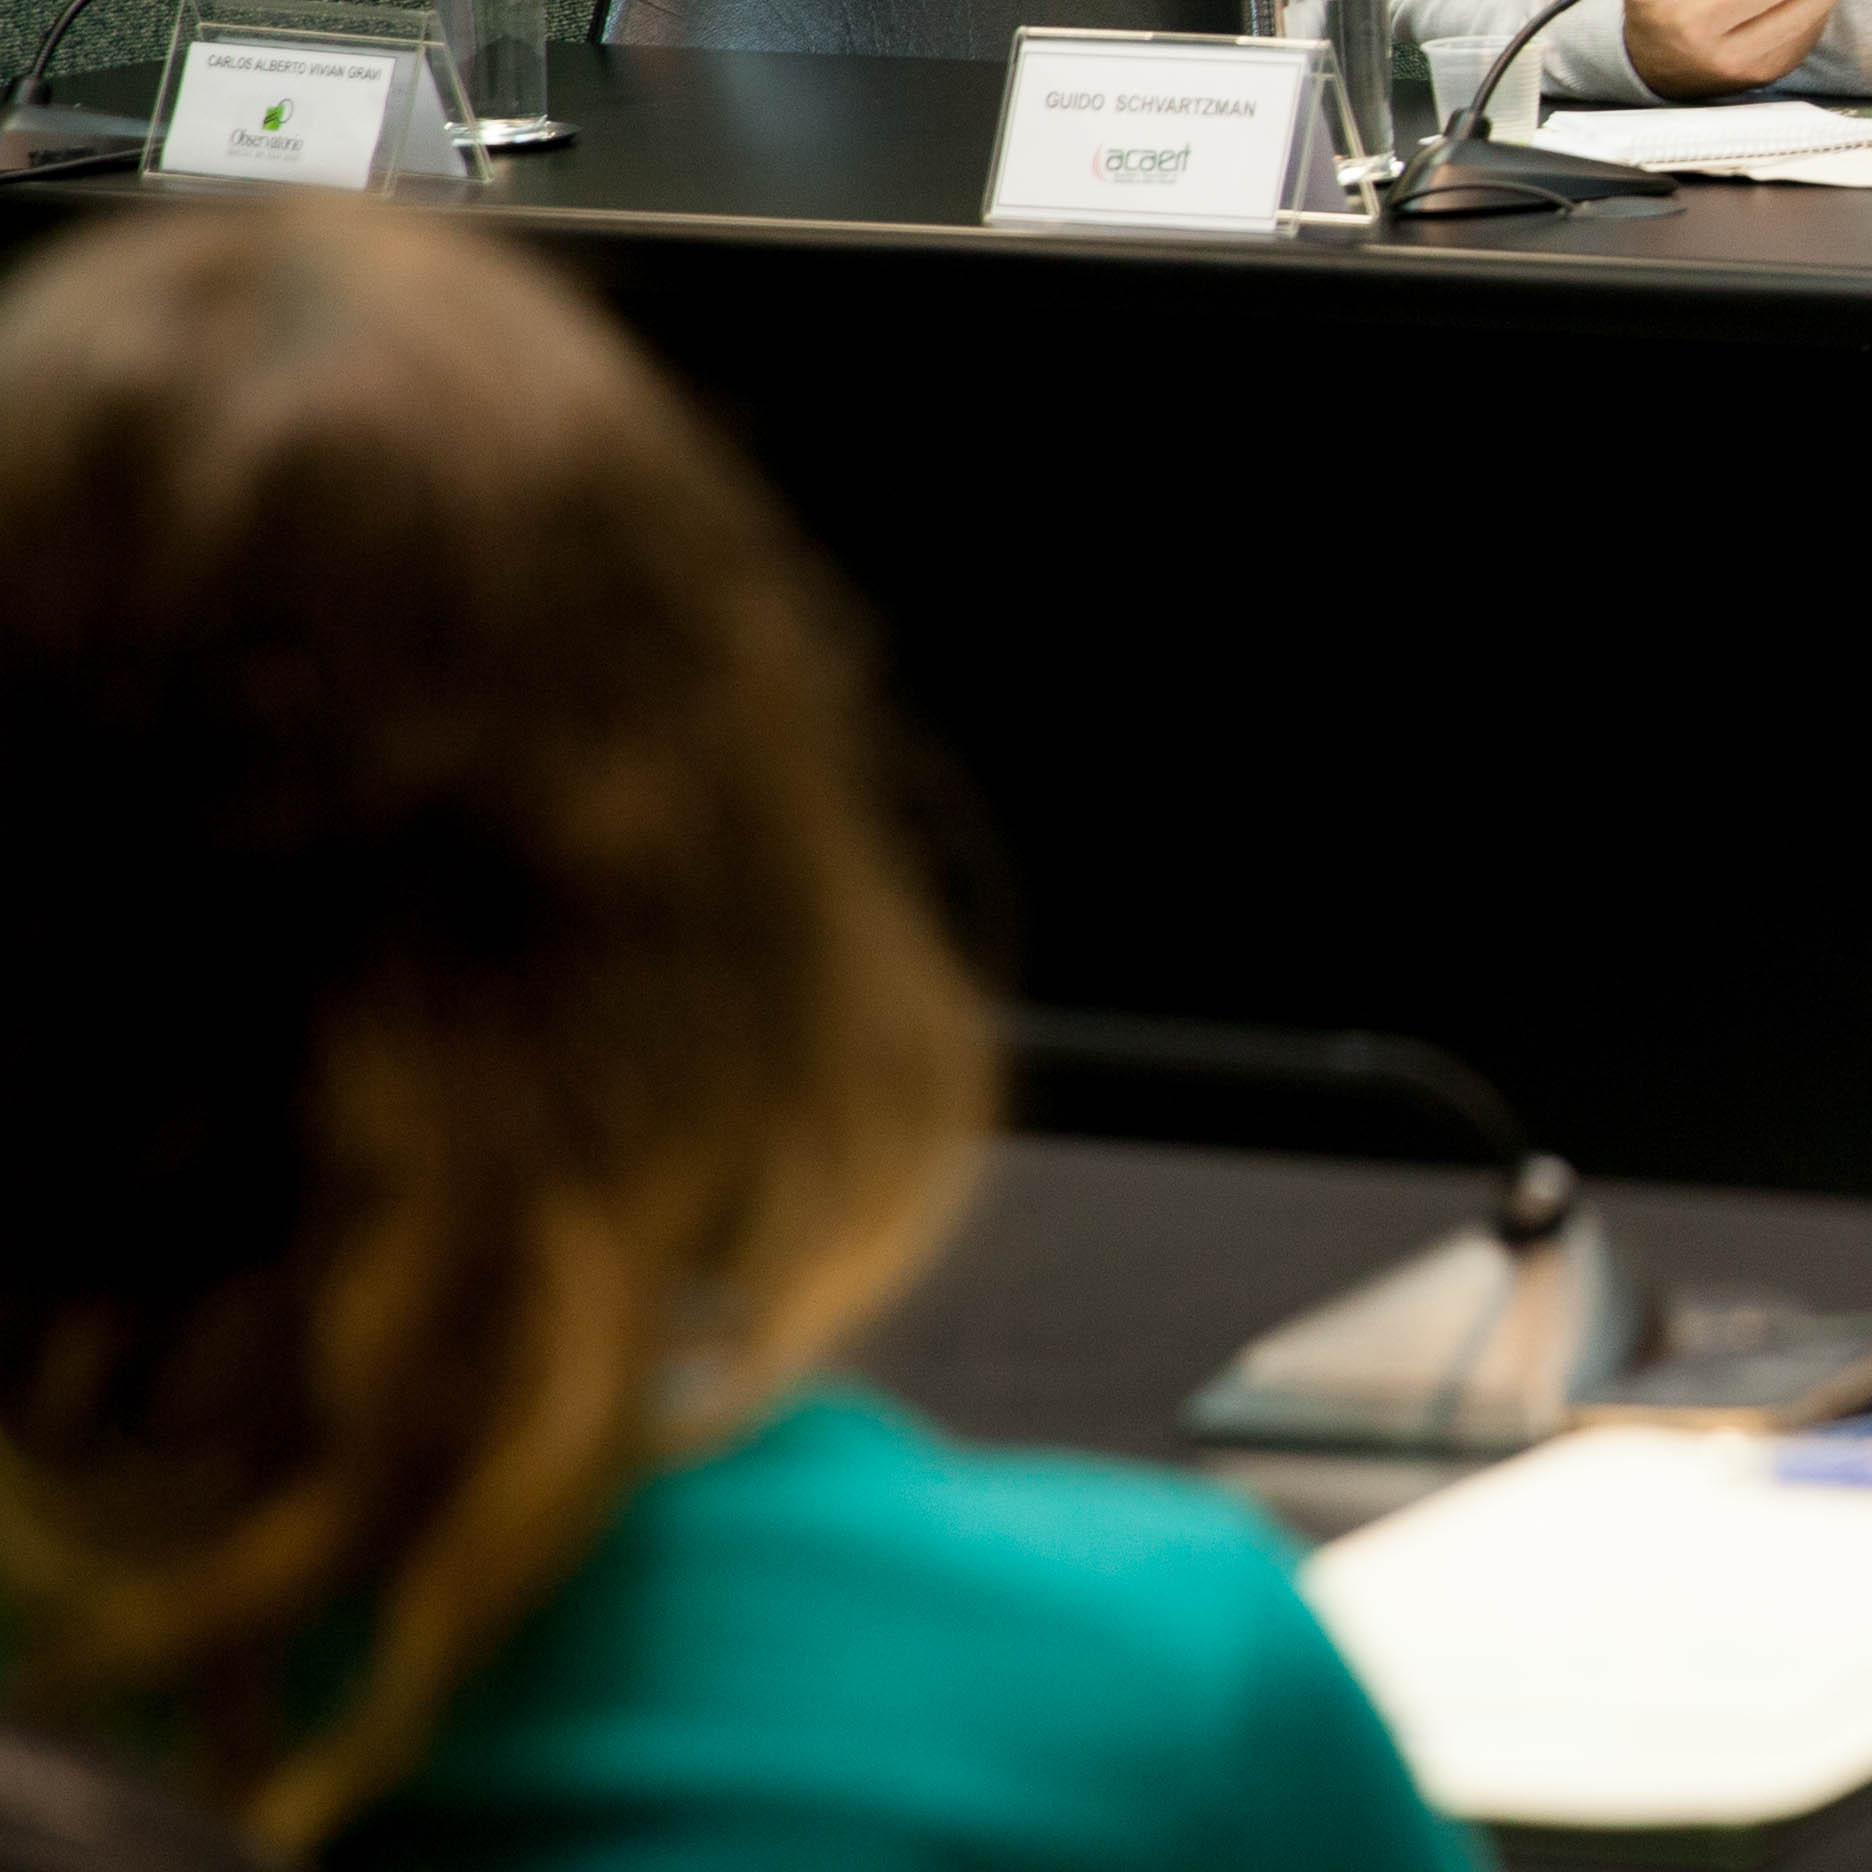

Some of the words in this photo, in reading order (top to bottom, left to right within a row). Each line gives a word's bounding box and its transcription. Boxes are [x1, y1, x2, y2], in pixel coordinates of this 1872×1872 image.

[207, 53, 251, 70] CARLOS
[253, 59, 307, 75] ALBERTO
[1045, 90, 1105, 111] GUIDO
[1115, 93, 1257, 118] SCHVARTZMAN
[1105, 142, 1192, 172] acaert
